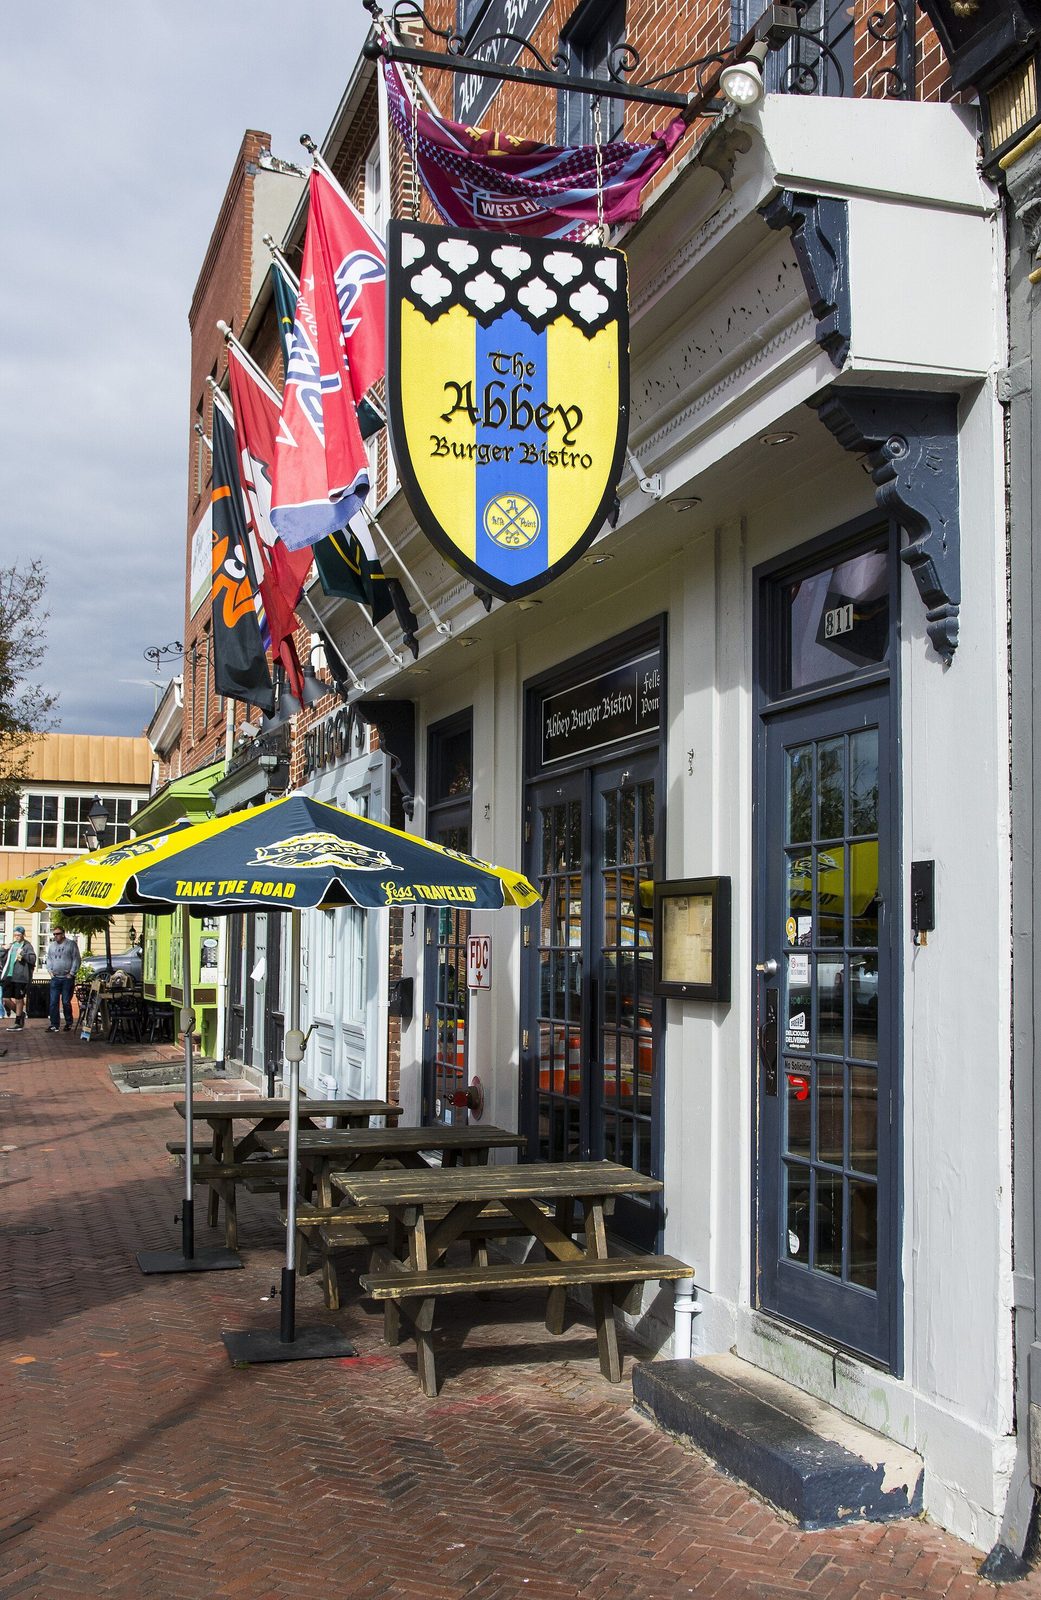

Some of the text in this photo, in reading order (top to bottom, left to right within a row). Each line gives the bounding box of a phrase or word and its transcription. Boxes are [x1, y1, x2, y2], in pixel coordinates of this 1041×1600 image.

[481, 202, 519, 217] WEST
[487, 351, 536, 380] The
[440, 380, 583, 446] Abbey
[430, 435, 592, 470] Burger Bistro
[826, 606, 851, 636] 811
[545, 691, 633, 740] Abbey Burger Bistro
[175, 880, 297, 899] TAKE THE ROAD
[380, 881, 417, 906] Less
[470, 940, 489, 969] FDC
